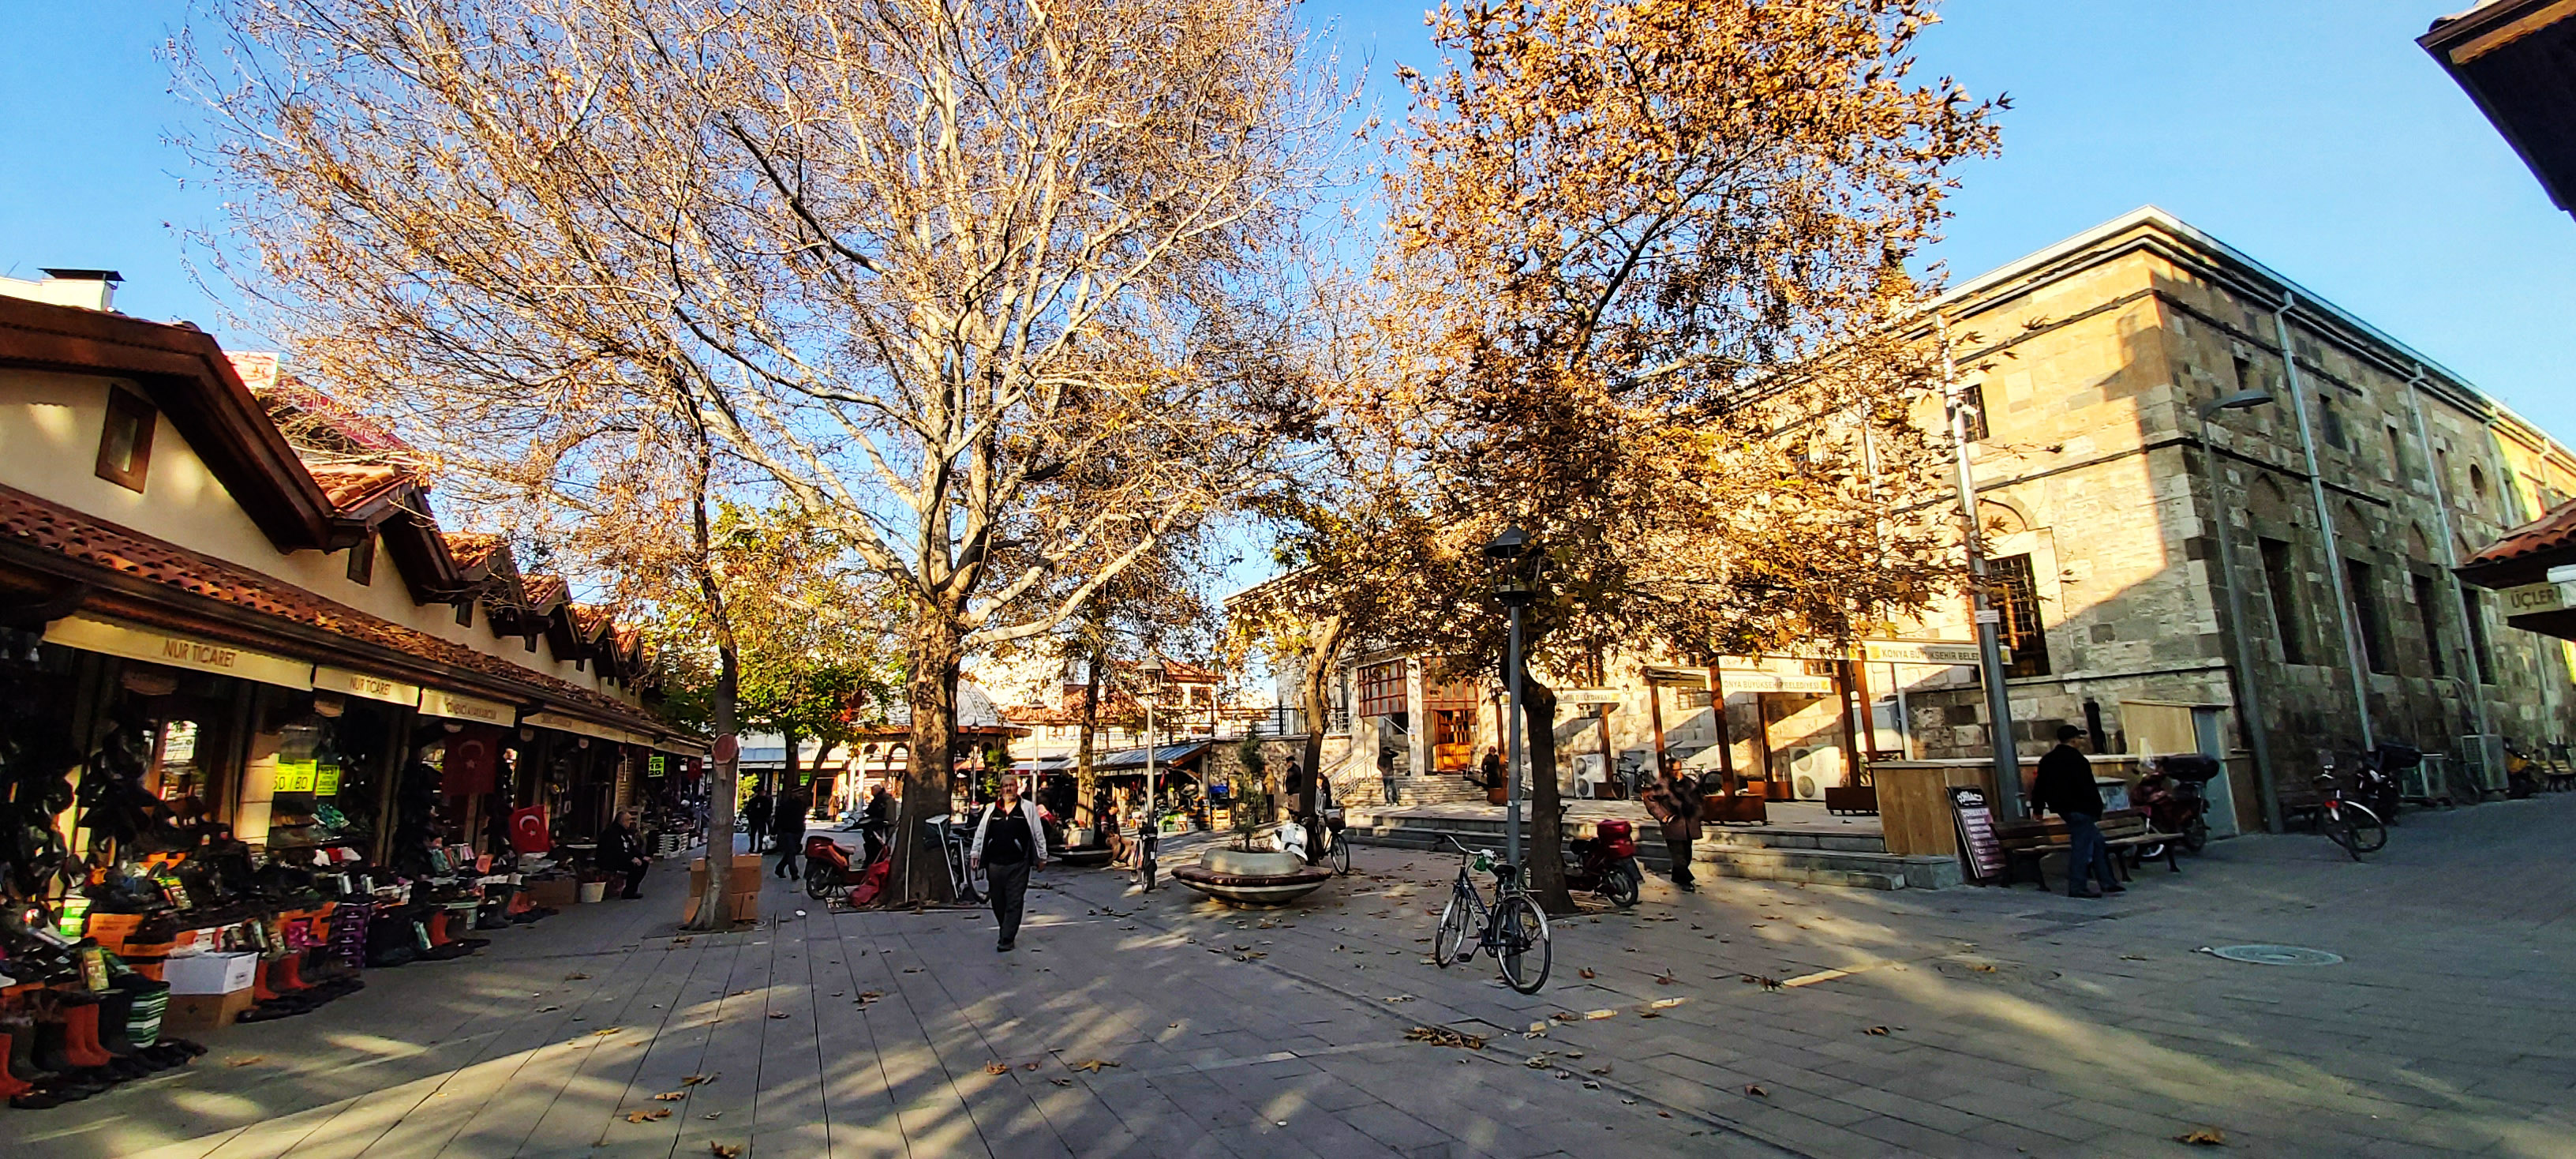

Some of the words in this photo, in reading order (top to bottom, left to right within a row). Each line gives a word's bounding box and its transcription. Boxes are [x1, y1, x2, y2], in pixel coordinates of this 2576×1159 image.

[2510, 589, 2554, 610] ÜÇLER
[163, 638, 189, 660] NUR
[1881, 649, 1909, 658] KONYA
[1958, 651, 1980, 661] BELED
[350, 677, 365, 691] NUR
